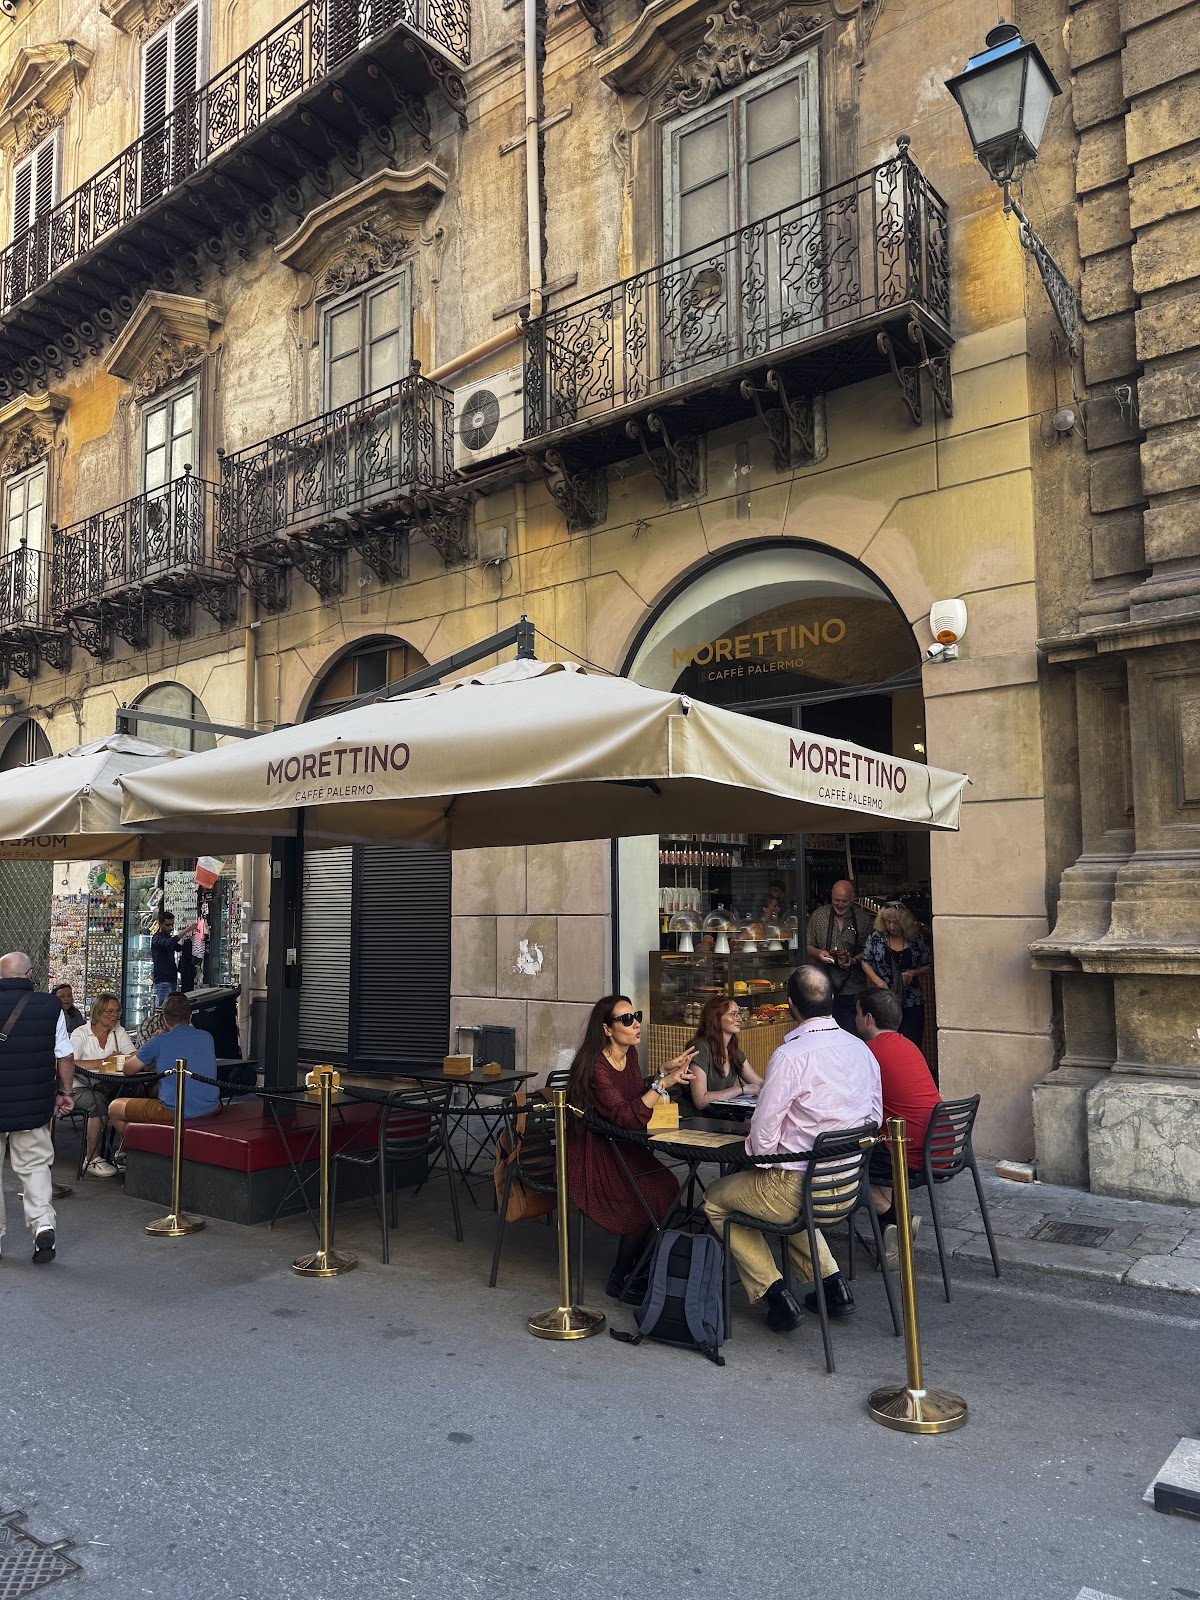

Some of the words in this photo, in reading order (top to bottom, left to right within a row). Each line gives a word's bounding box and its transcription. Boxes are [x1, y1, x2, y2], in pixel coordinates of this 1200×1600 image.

[672, 618, 846, 669] MORETTINO
[708, 665, 744, 681] CAFFÈ
[748, 658, 804, 675] PALERMO
[266, 742, 410, 786] MORETTINO
[789, 737, 907, 794] MORETTINO
[295, 786, 324, 801] CAFFÈ
[327, 784, 374, 797] PALERMO
[818, 787, 846, 802] CAFFÈ
[848, 792, 883, 810] PALERMO
